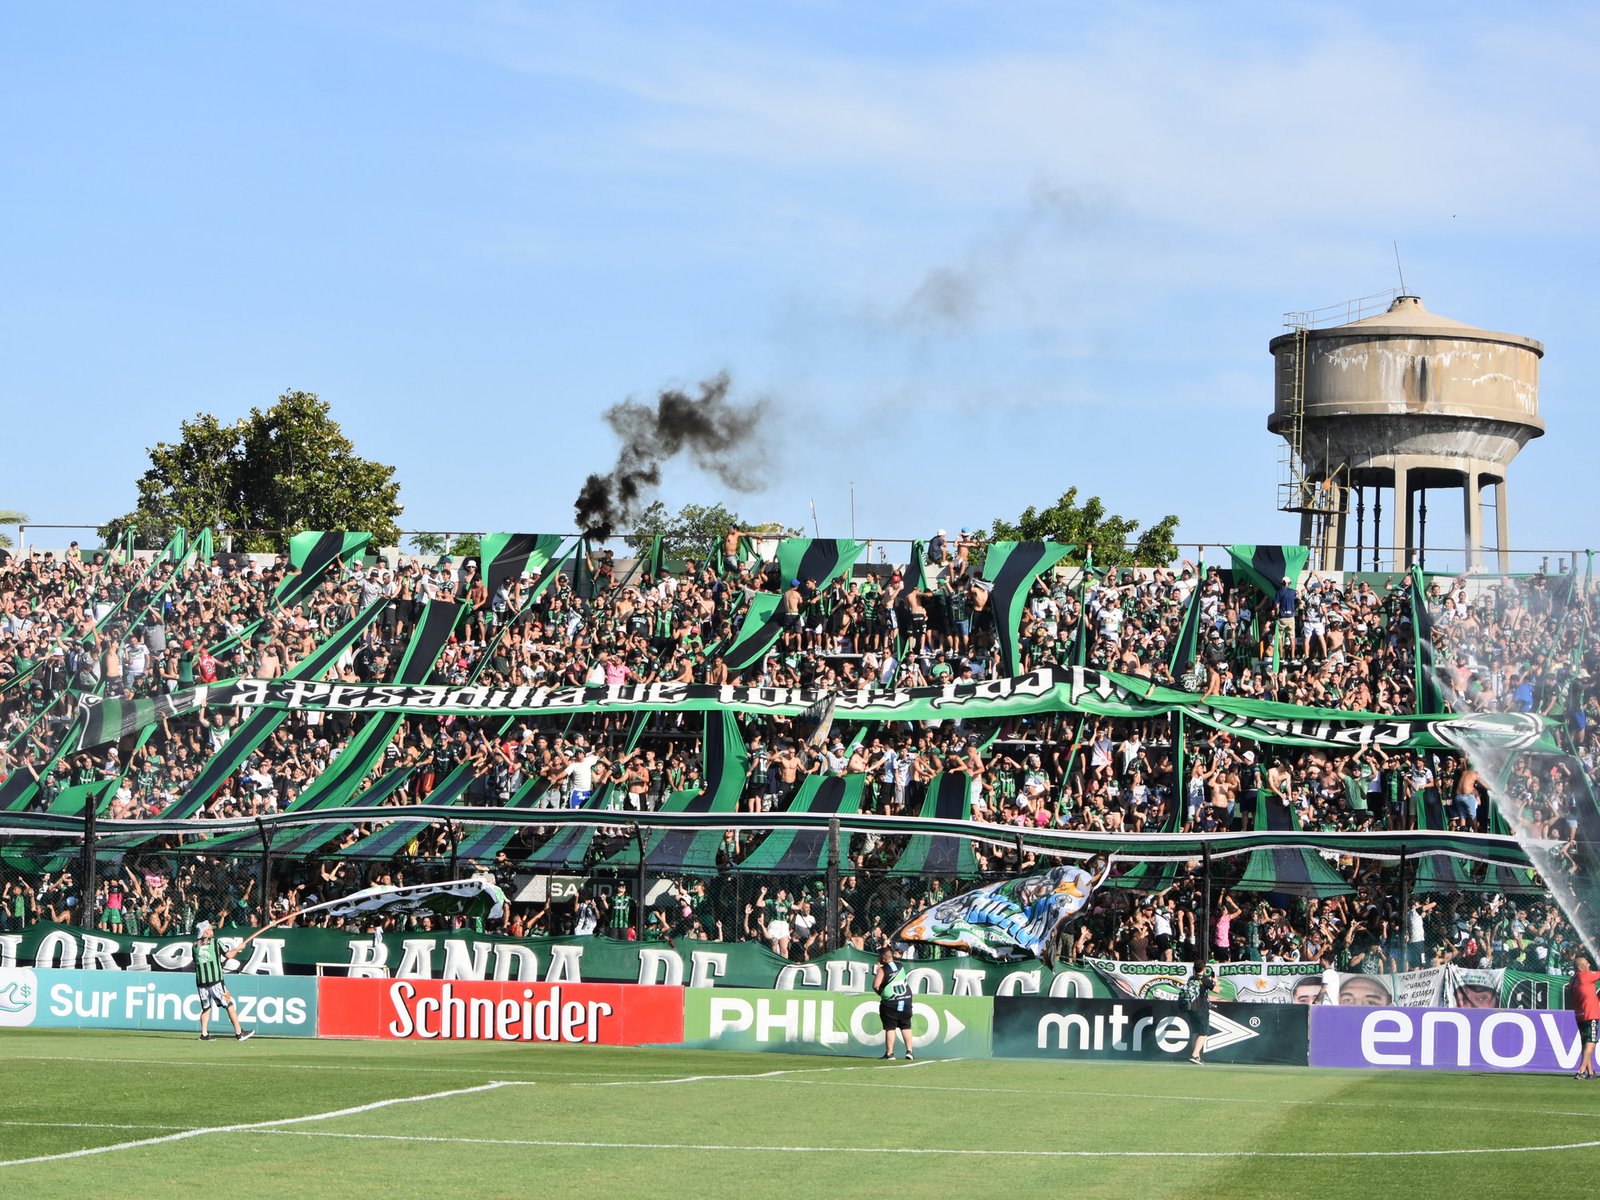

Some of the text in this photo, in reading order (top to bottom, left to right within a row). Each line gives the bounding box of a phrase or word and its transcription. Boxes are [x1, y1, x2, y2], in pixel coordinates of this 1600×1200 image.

[1097, 961, 1115, 971] OS
[1120, 963, 1187, 976] COBARDES
[1220, 964, 1262, 976] HACEN
[50, 983, 119, 1018] Sur
[389, 981, 612, 1043] Schneider
[1038, 1005, 1191, 1053] mitre
[1361, 1010, 1600, 1069] enov
